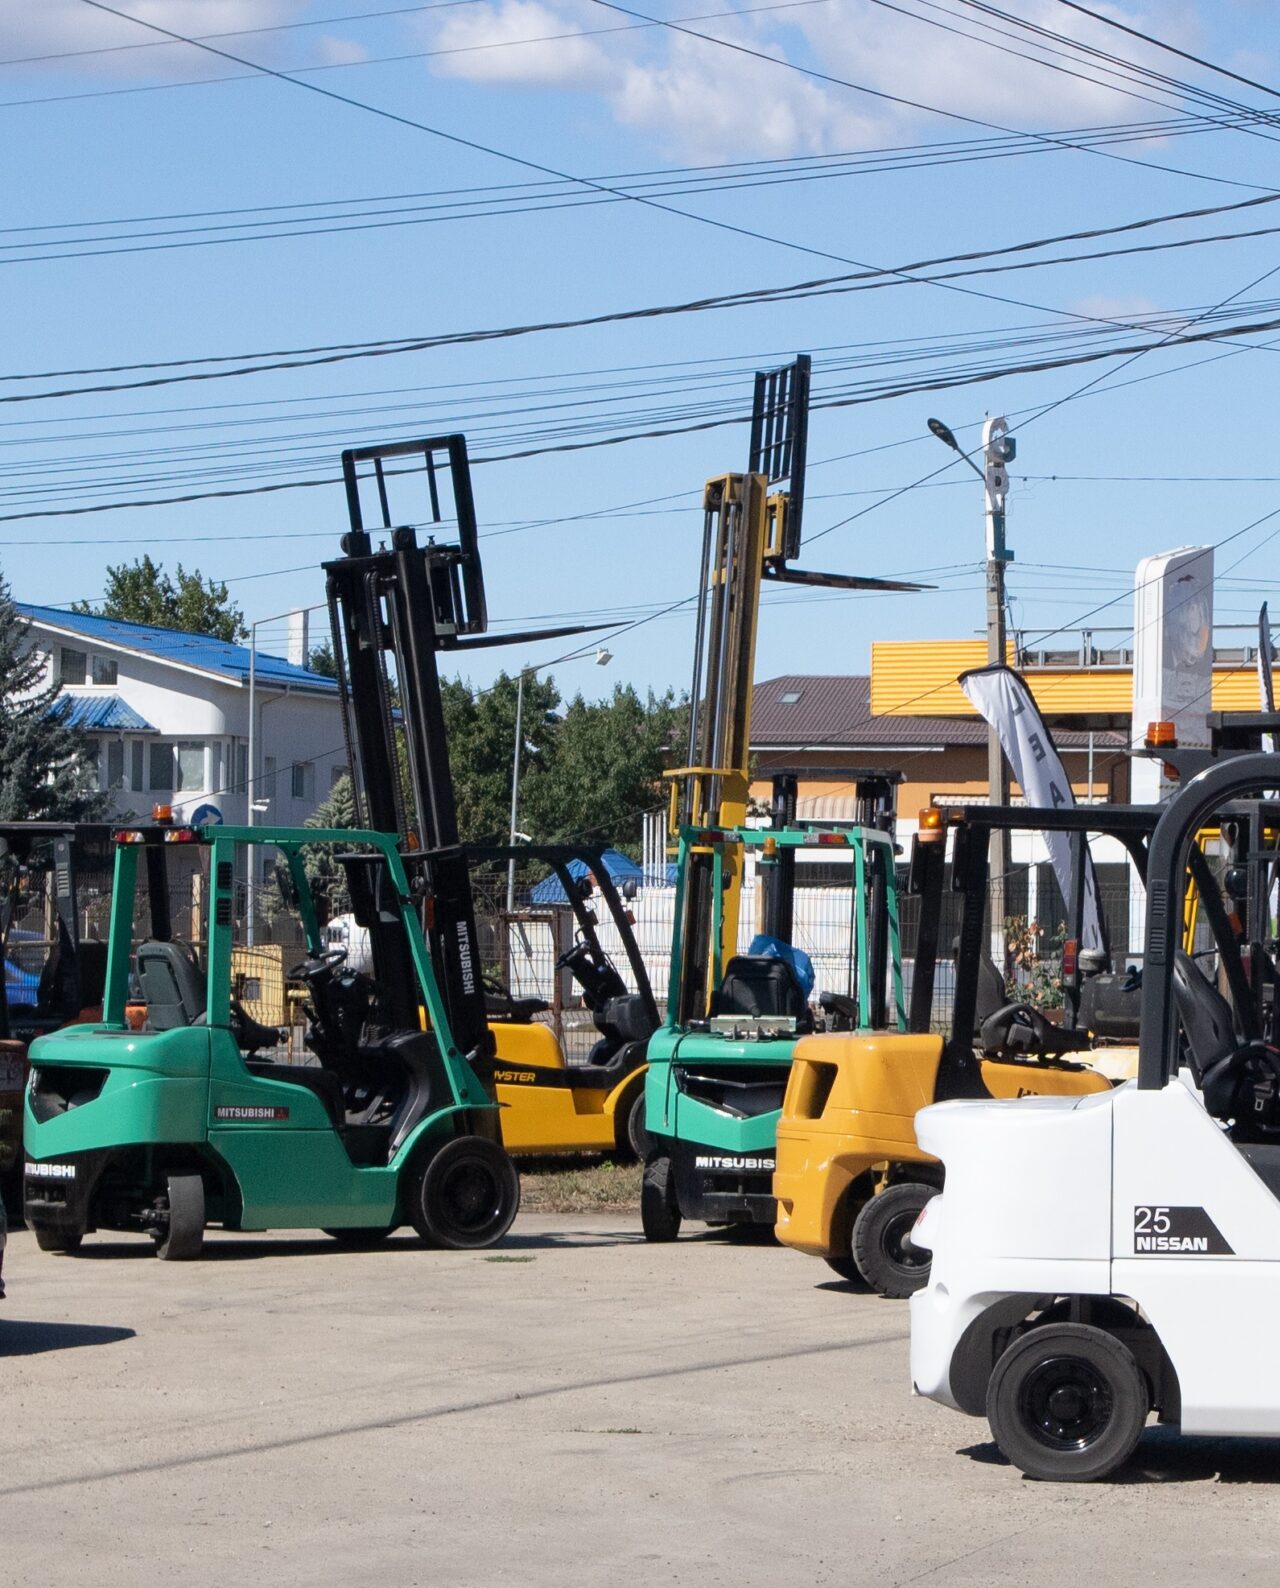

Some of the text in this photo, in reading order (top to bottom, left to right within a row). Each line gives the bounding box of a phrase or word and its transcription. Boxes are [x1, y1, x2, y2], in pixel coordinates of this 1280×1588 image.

[456, 921, 475, 995] MITSUBISHI
[217, 1107, 275, 1118] MITSUBISHI
[695, 1156, 776, 1169] MITSUBIS
[1134, 1207, 1171, 1234] 25
[1136, 1236, 1208, 1251] NISSAN
